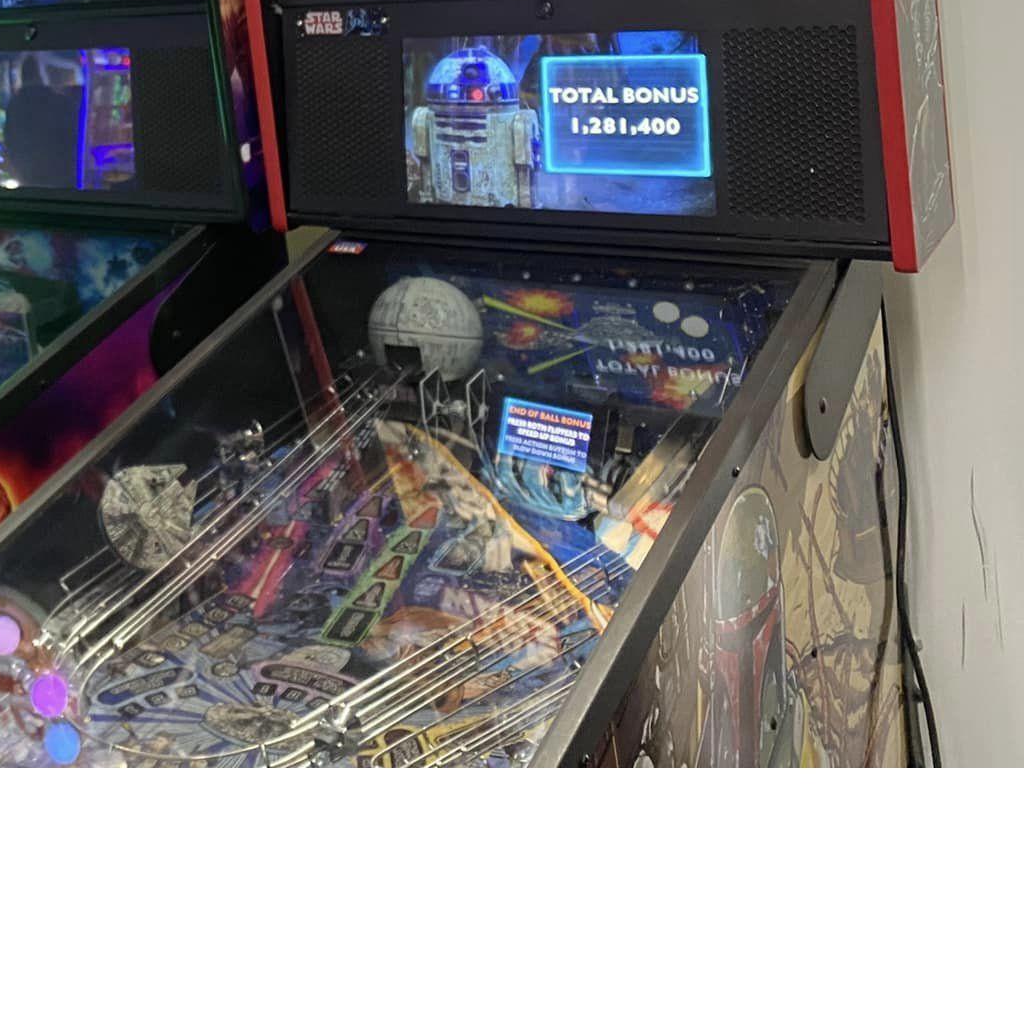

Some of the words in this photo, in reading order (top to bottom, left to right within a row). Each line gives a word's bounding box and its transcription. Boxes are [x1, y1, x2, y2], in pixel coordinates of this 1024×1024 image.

[304, 10, 343, 24] STAR
[304, 22, 343, 35] WARS
[549, 86, 619, 104] TOTAL
[623, 86, 699, 104] BONUS
[571, 117, 681, 136] 1,281,400
[509, 405, 527, 416] END
[527, 409, 539, 418] OF
[540, 412, 560, 423] BALL
[560, 416, 591, 430] BONUS
[527, 420, 548, 430] BOTH
[576, 432, 590, 441] TO
